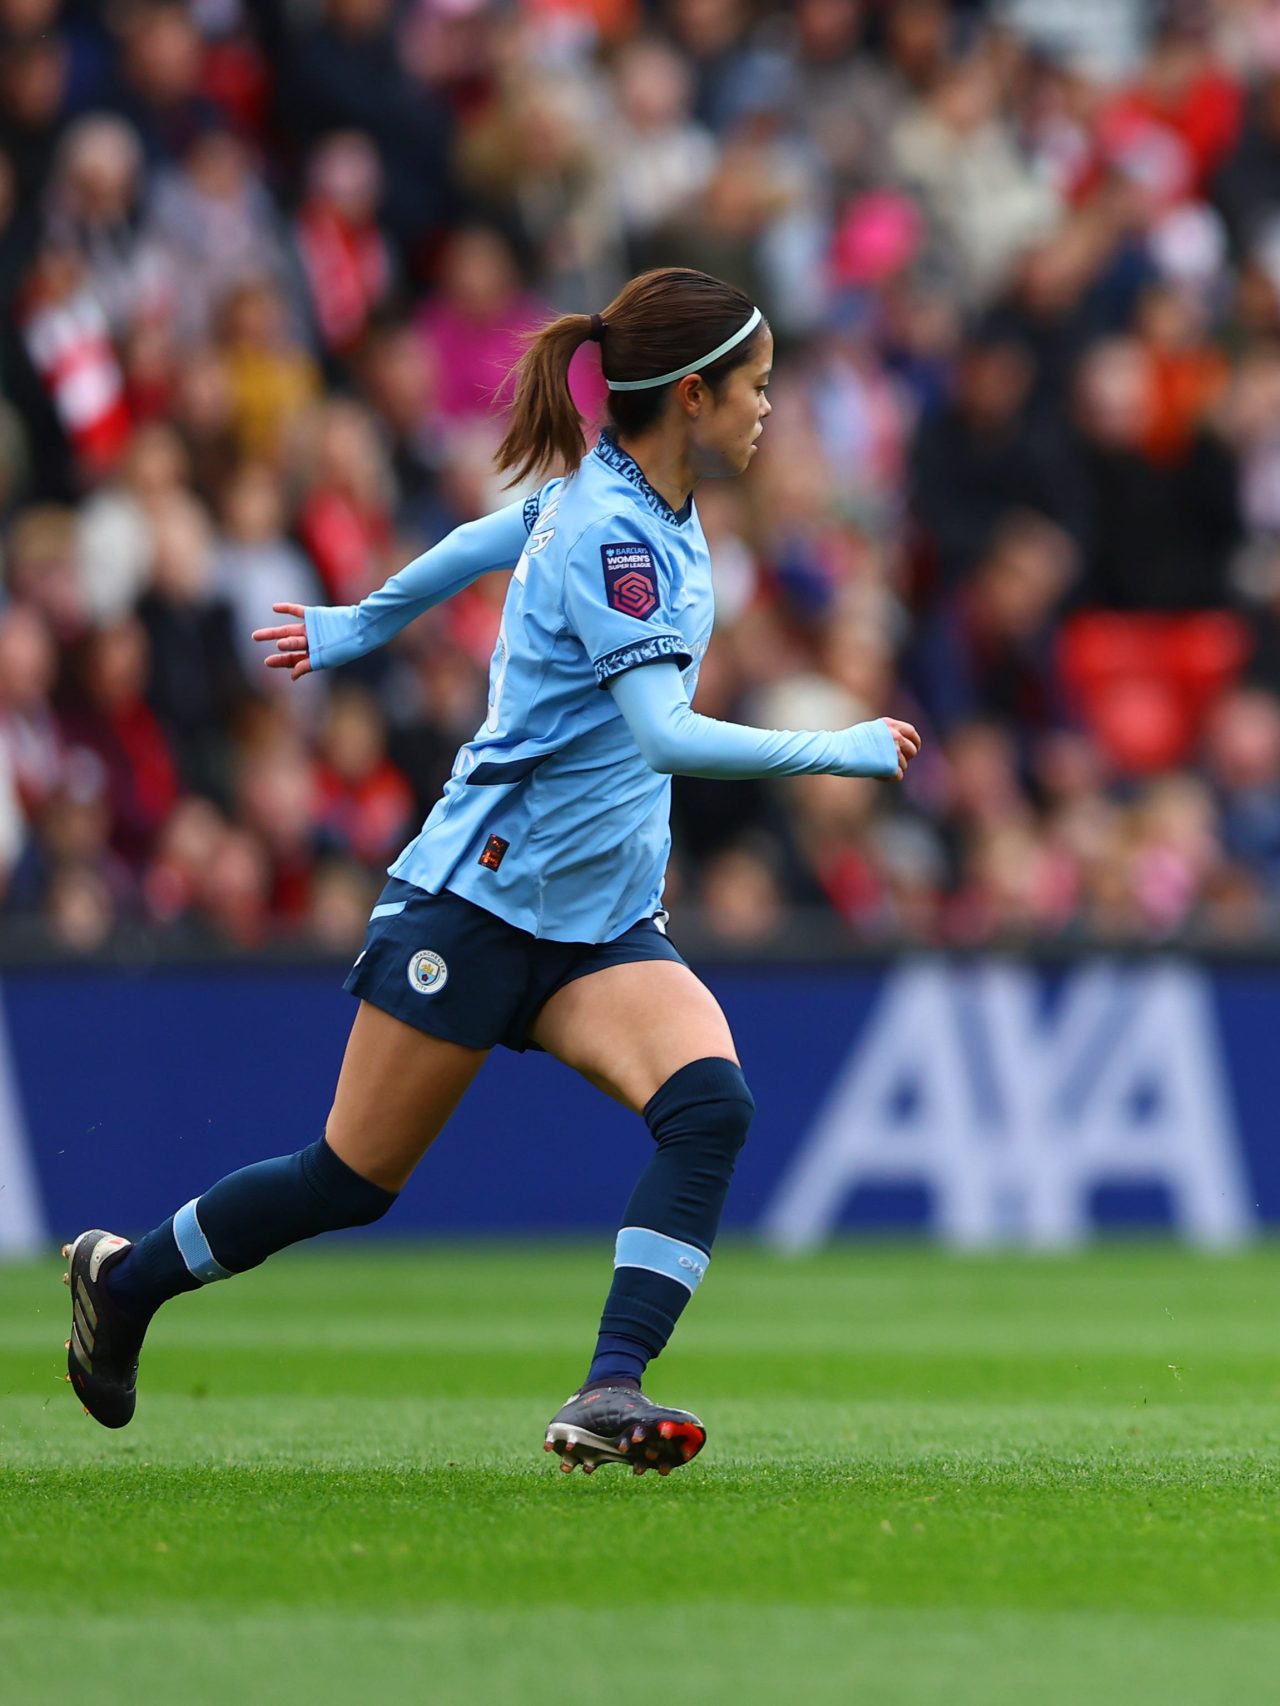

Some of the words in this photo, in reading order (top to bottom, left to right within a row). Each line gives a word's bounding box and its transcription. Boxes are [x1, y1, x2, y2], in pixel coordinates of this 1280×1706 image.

[615, 547, 648, 555] BARCLAYS
[607, 555, 650, 564] WOMEN'S
[608, 562, 630, 571] SUPER
[630, 561, 652, 569] LEAGUE
[415, 951, 447, 974] MANCHESTER
[415, 983, 428, 992] CITY
